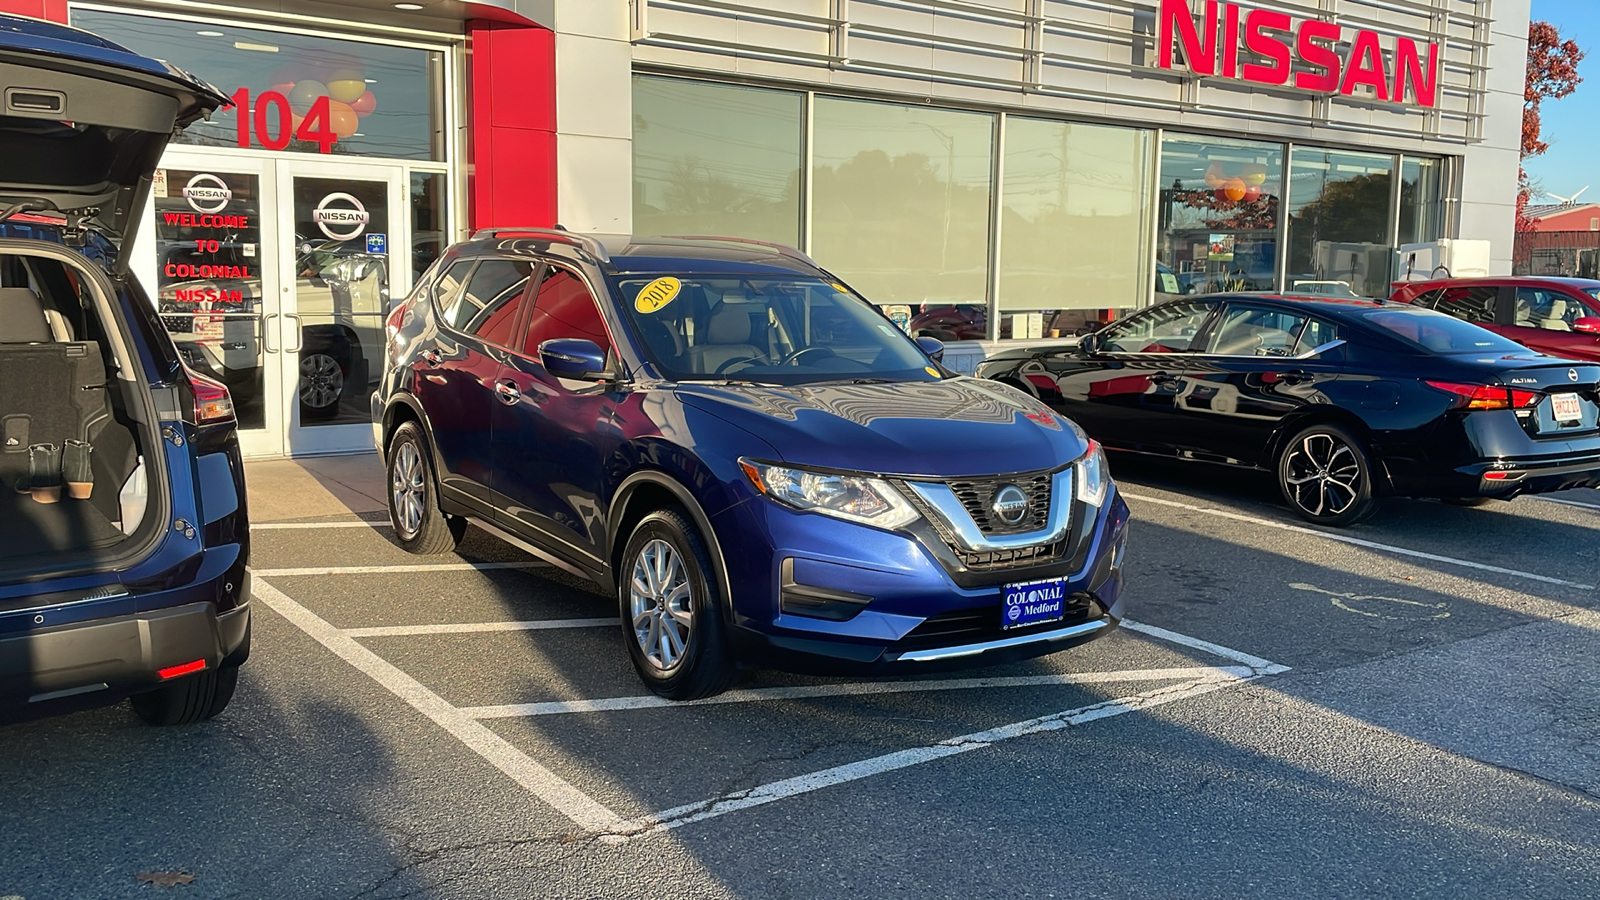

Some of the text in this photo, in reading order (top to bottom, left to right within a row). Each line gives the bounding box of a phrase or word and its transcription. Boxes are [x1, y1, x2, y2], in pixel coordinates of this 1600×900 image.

[1158, 0, 1438, 107] NISSAN
[222, 87, 338, 154] 104
[187, 189, 228, 198] NISSAN
[163, 212, 249, 229] WELCOME
[318, 212, 364, 221] NISSAN
[194, 239, 220, 253] TO
[164, 263, 252, 278] COLONIAL
[175, 288, 243, 303] NISSAN
[642, 280, 675, 308] 2018
[1000, 502, 1027, 510] NISSAN
[1007, 587, 1063, 606] COLONIAL
[1024, 602, 1059, 616] Medford
